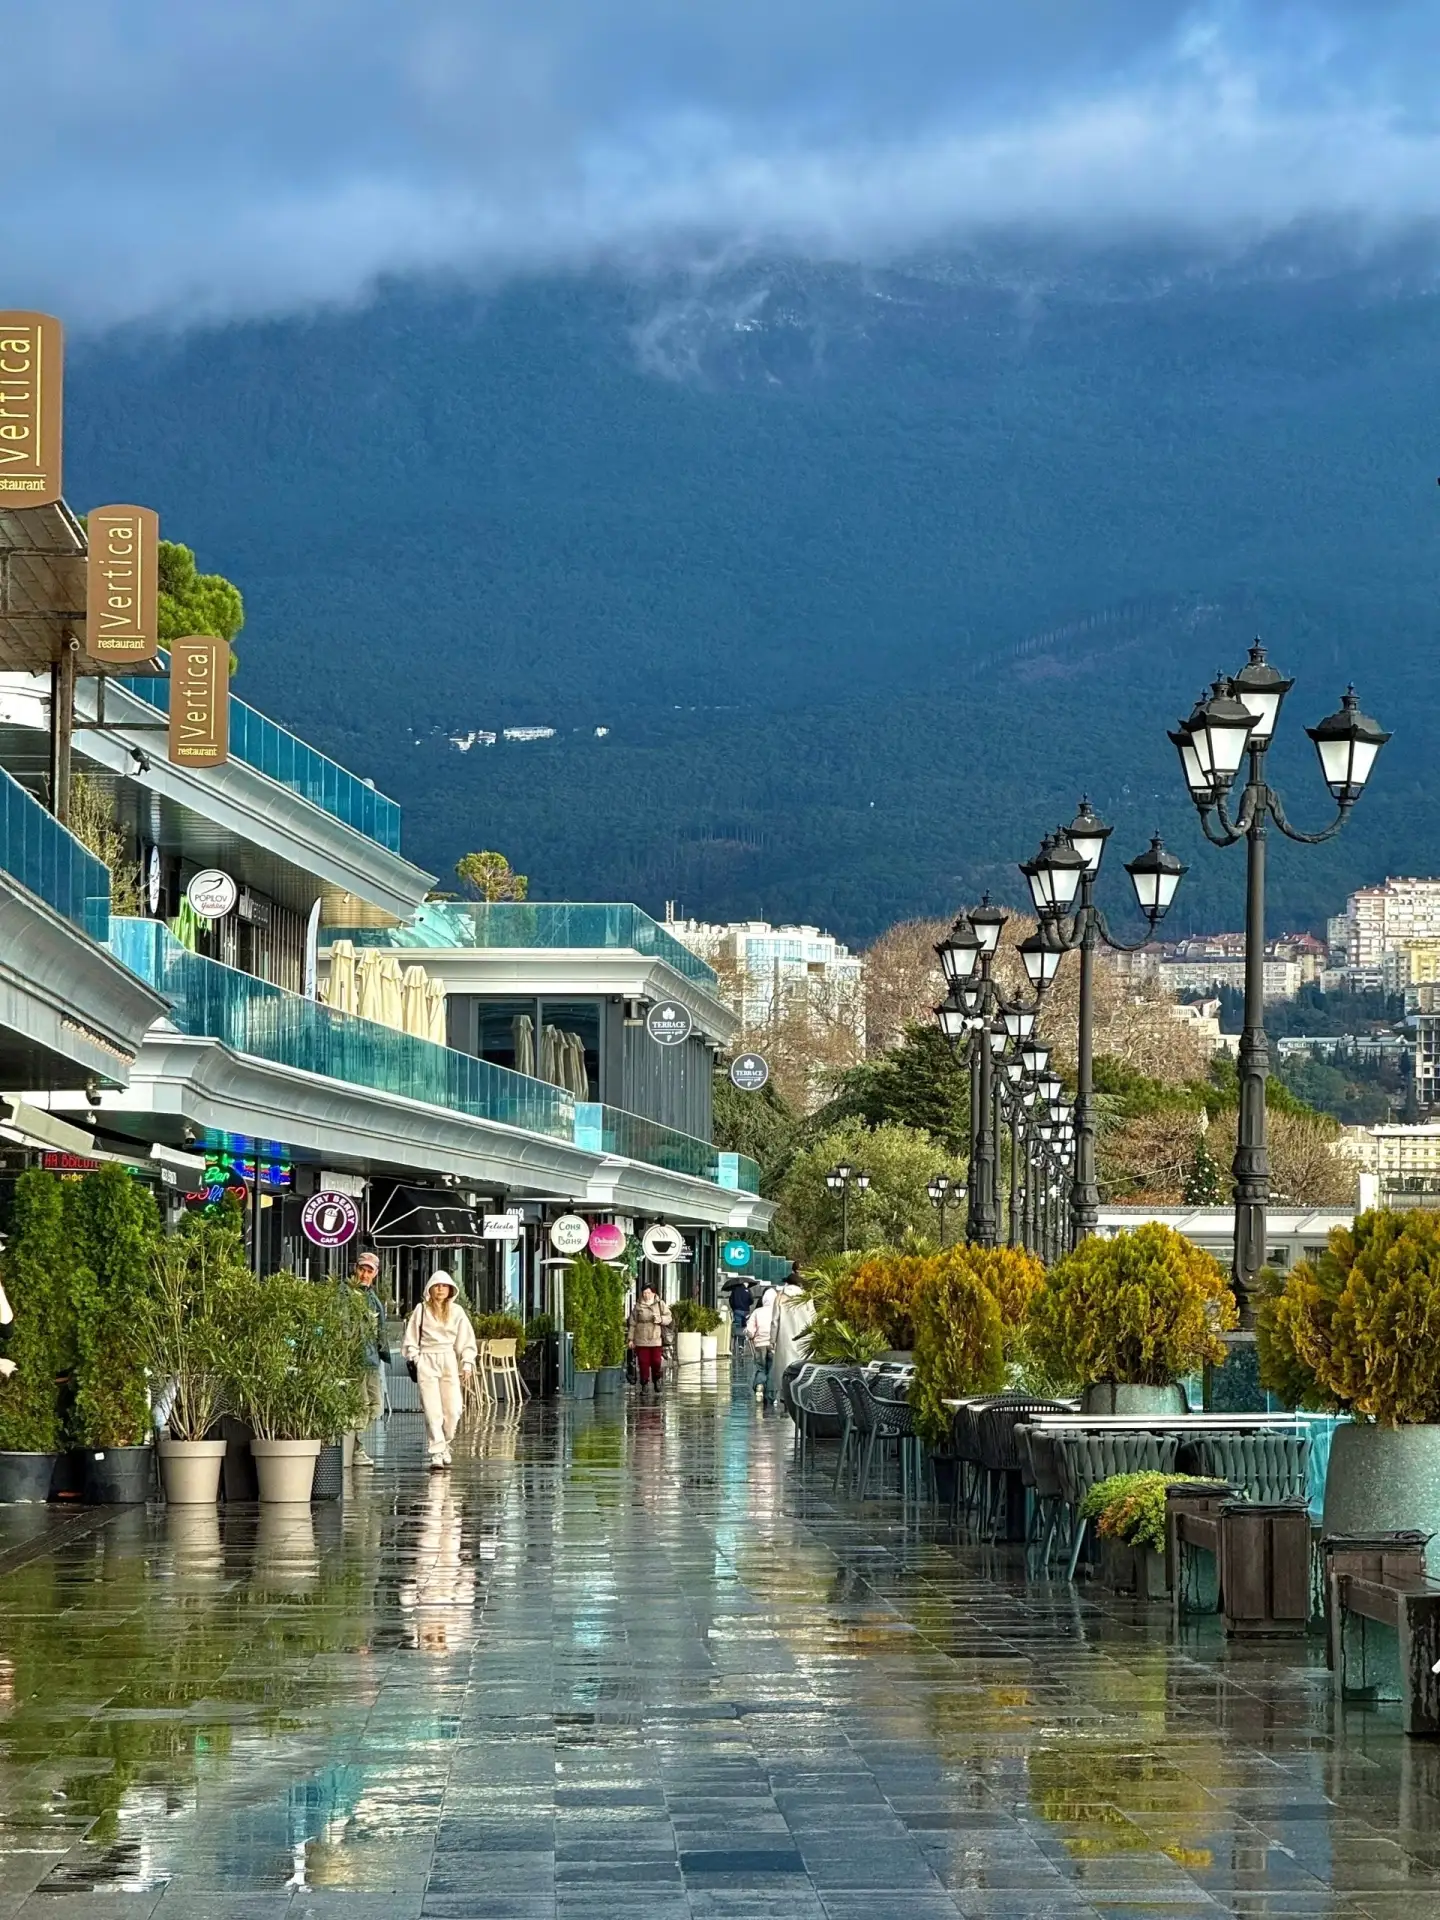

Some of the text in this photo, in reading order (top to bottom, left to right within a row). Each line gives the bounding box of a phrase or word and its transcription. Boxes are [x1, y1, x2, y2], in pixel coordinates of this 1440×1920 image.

[98, 516, 133, 629] Vertical
[97, 638, 145, 650] restaurant
[179, 645, 209, 740] Vertical
[177, 746, 218, 757] restaurant
[194, 894, 228, 903] POPILOV
[651, 1021, 686, 1029] TERRACE
[204, 1166, 230, 1182] Bar
[305, 1195, 356, 1224] MERRY BERRY
[558, 1221, 581, 1231] Соня
[557, 1236, 583, 1245] Ваня
